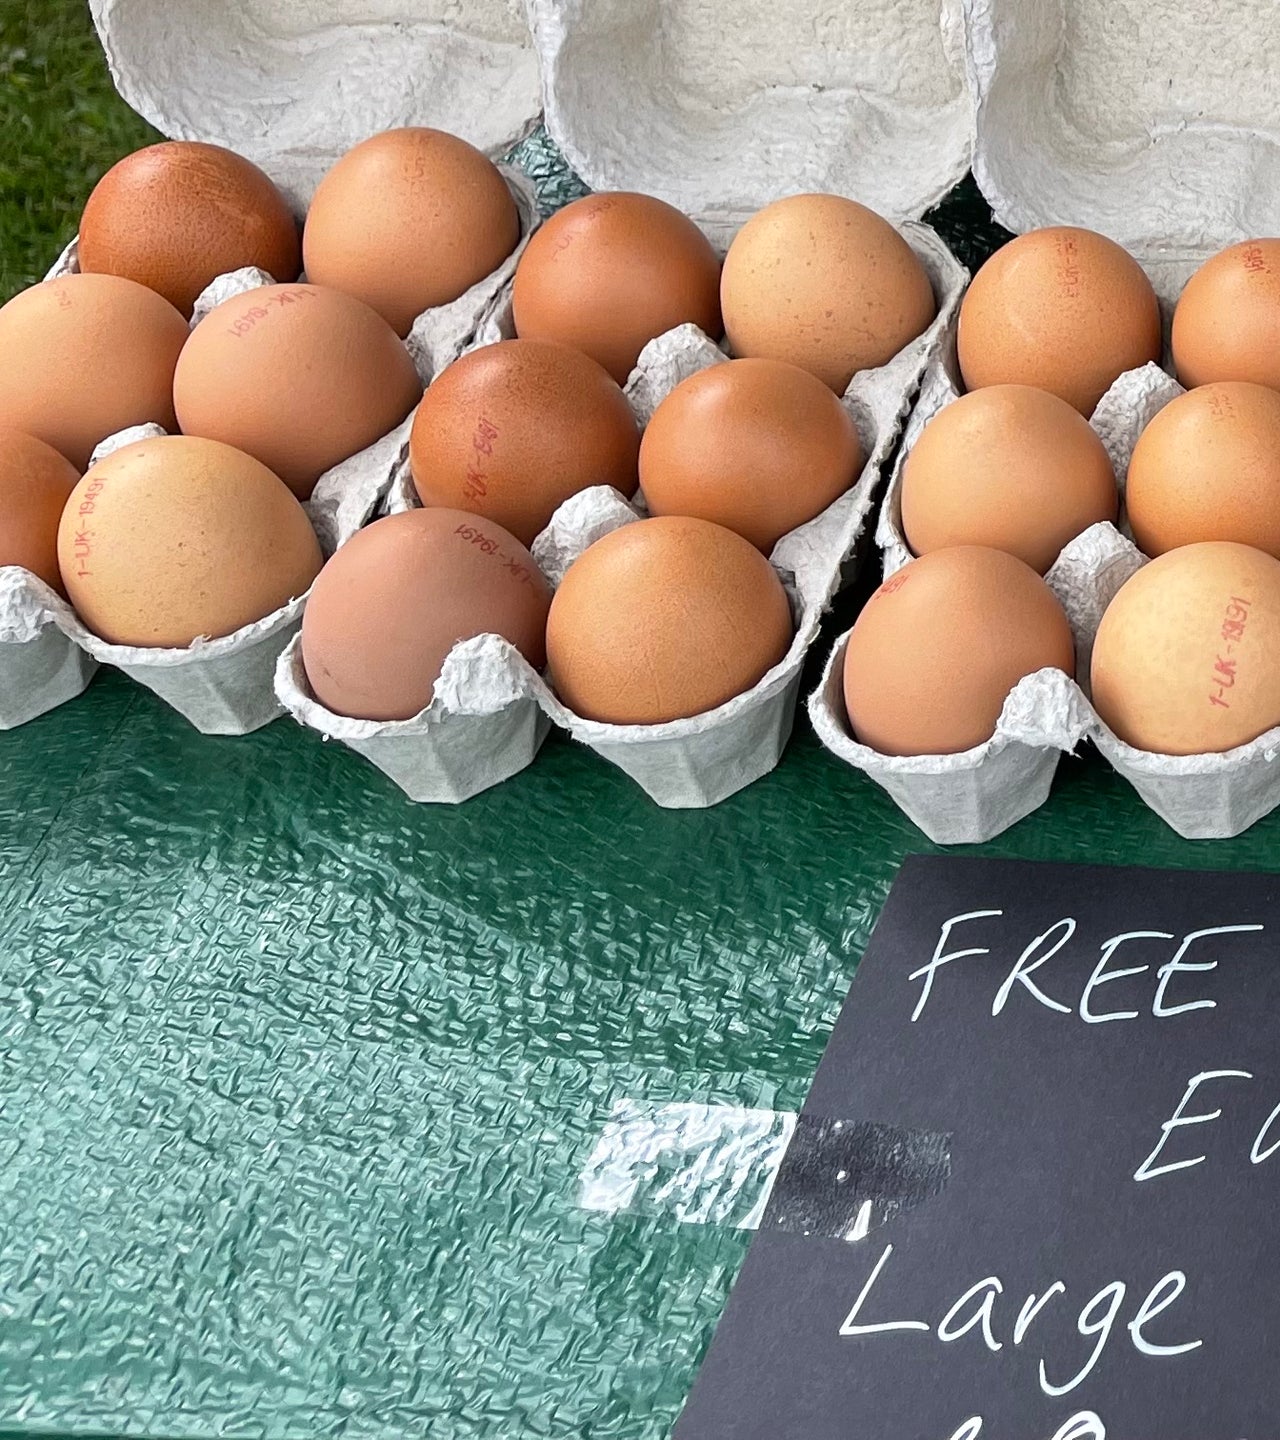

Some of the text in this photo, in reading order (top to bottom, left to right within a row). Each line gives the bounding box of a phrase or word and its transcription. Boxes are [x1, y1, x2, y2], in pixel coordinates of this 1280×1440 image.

[74, 475, 109, 581] 1-UK-19491
[908, 909, 1265, 1024] FREE
[838, 1243, 1203, 1398] Large
